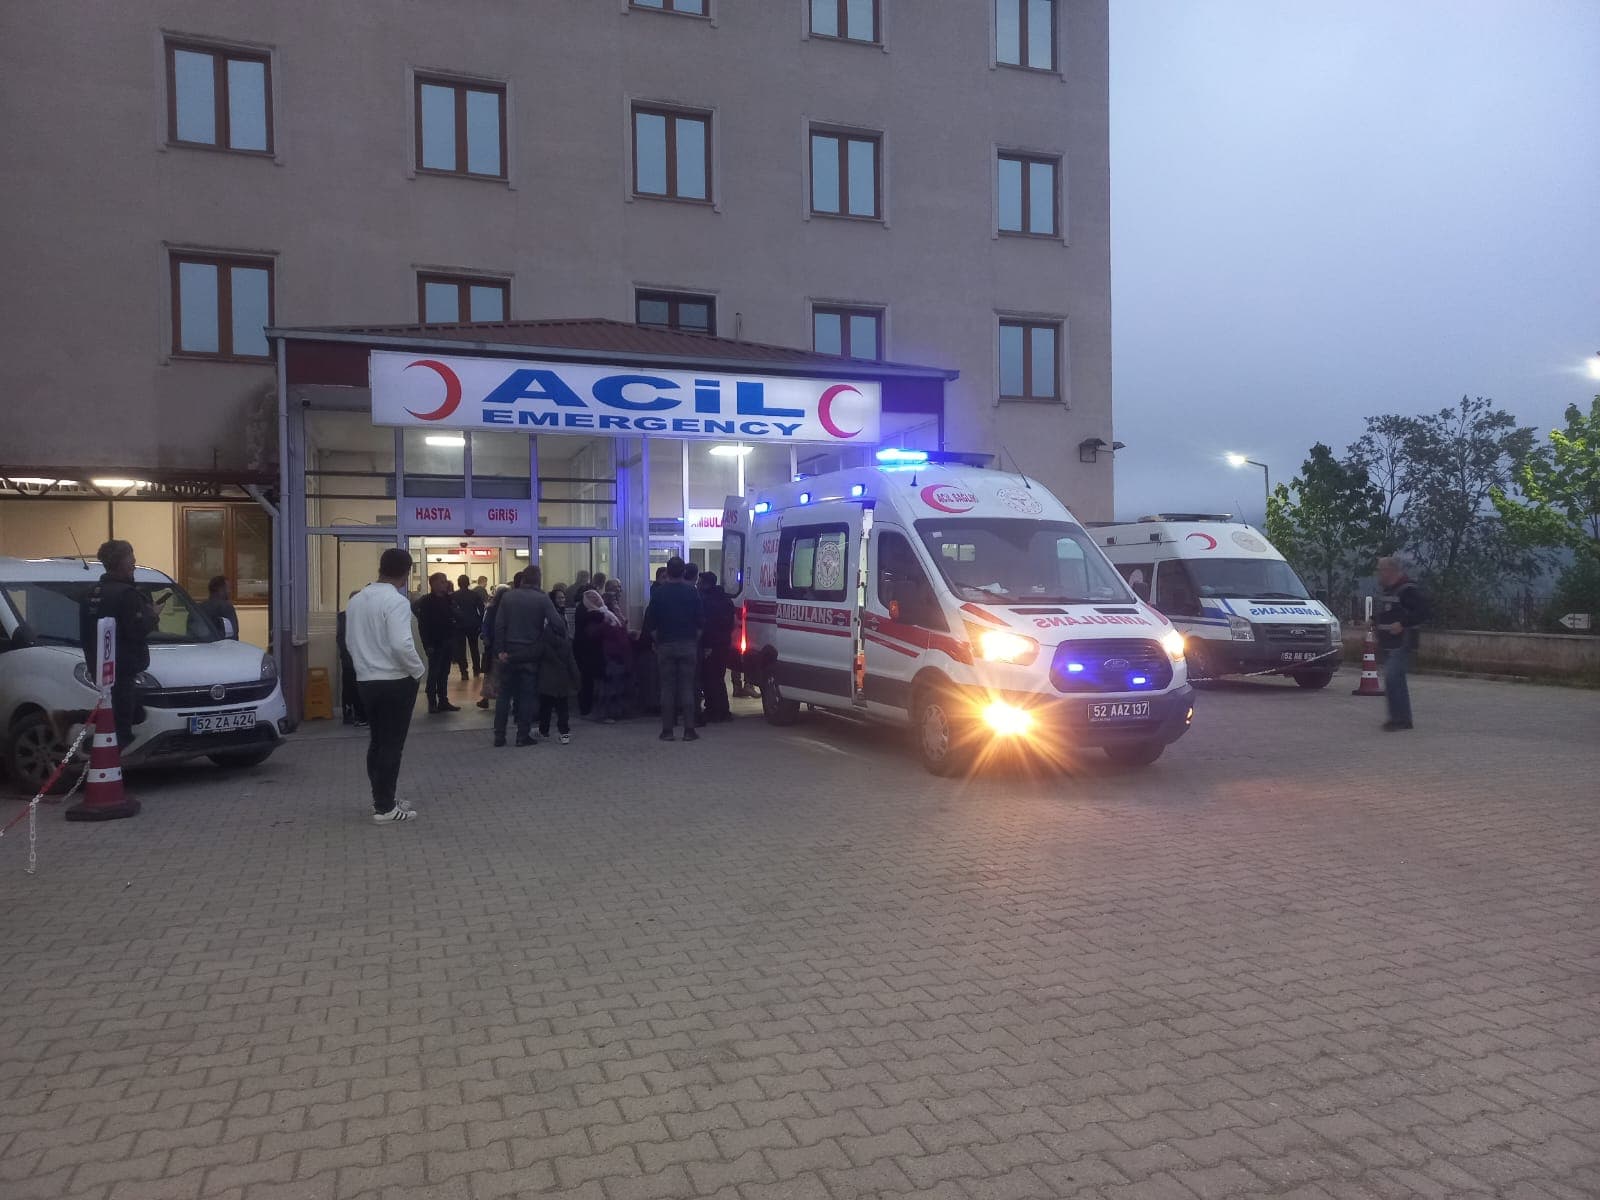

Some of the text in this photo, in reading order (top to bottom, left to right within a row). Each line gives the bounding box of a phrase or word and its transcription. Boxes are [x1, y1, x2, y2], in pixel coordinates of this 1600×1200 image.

[482, 408, 804, 437] EMERGENCY
[415, 507, 451, 521] HASTA
[776, 602, 834, 625] AMBULANS
[1094, 702, 1148, 717] 52 AAZ 137
[197, 718, 211, 730] 52
[215, 716, 230, 728] ZA
[233, 714, 254, 727] 424
